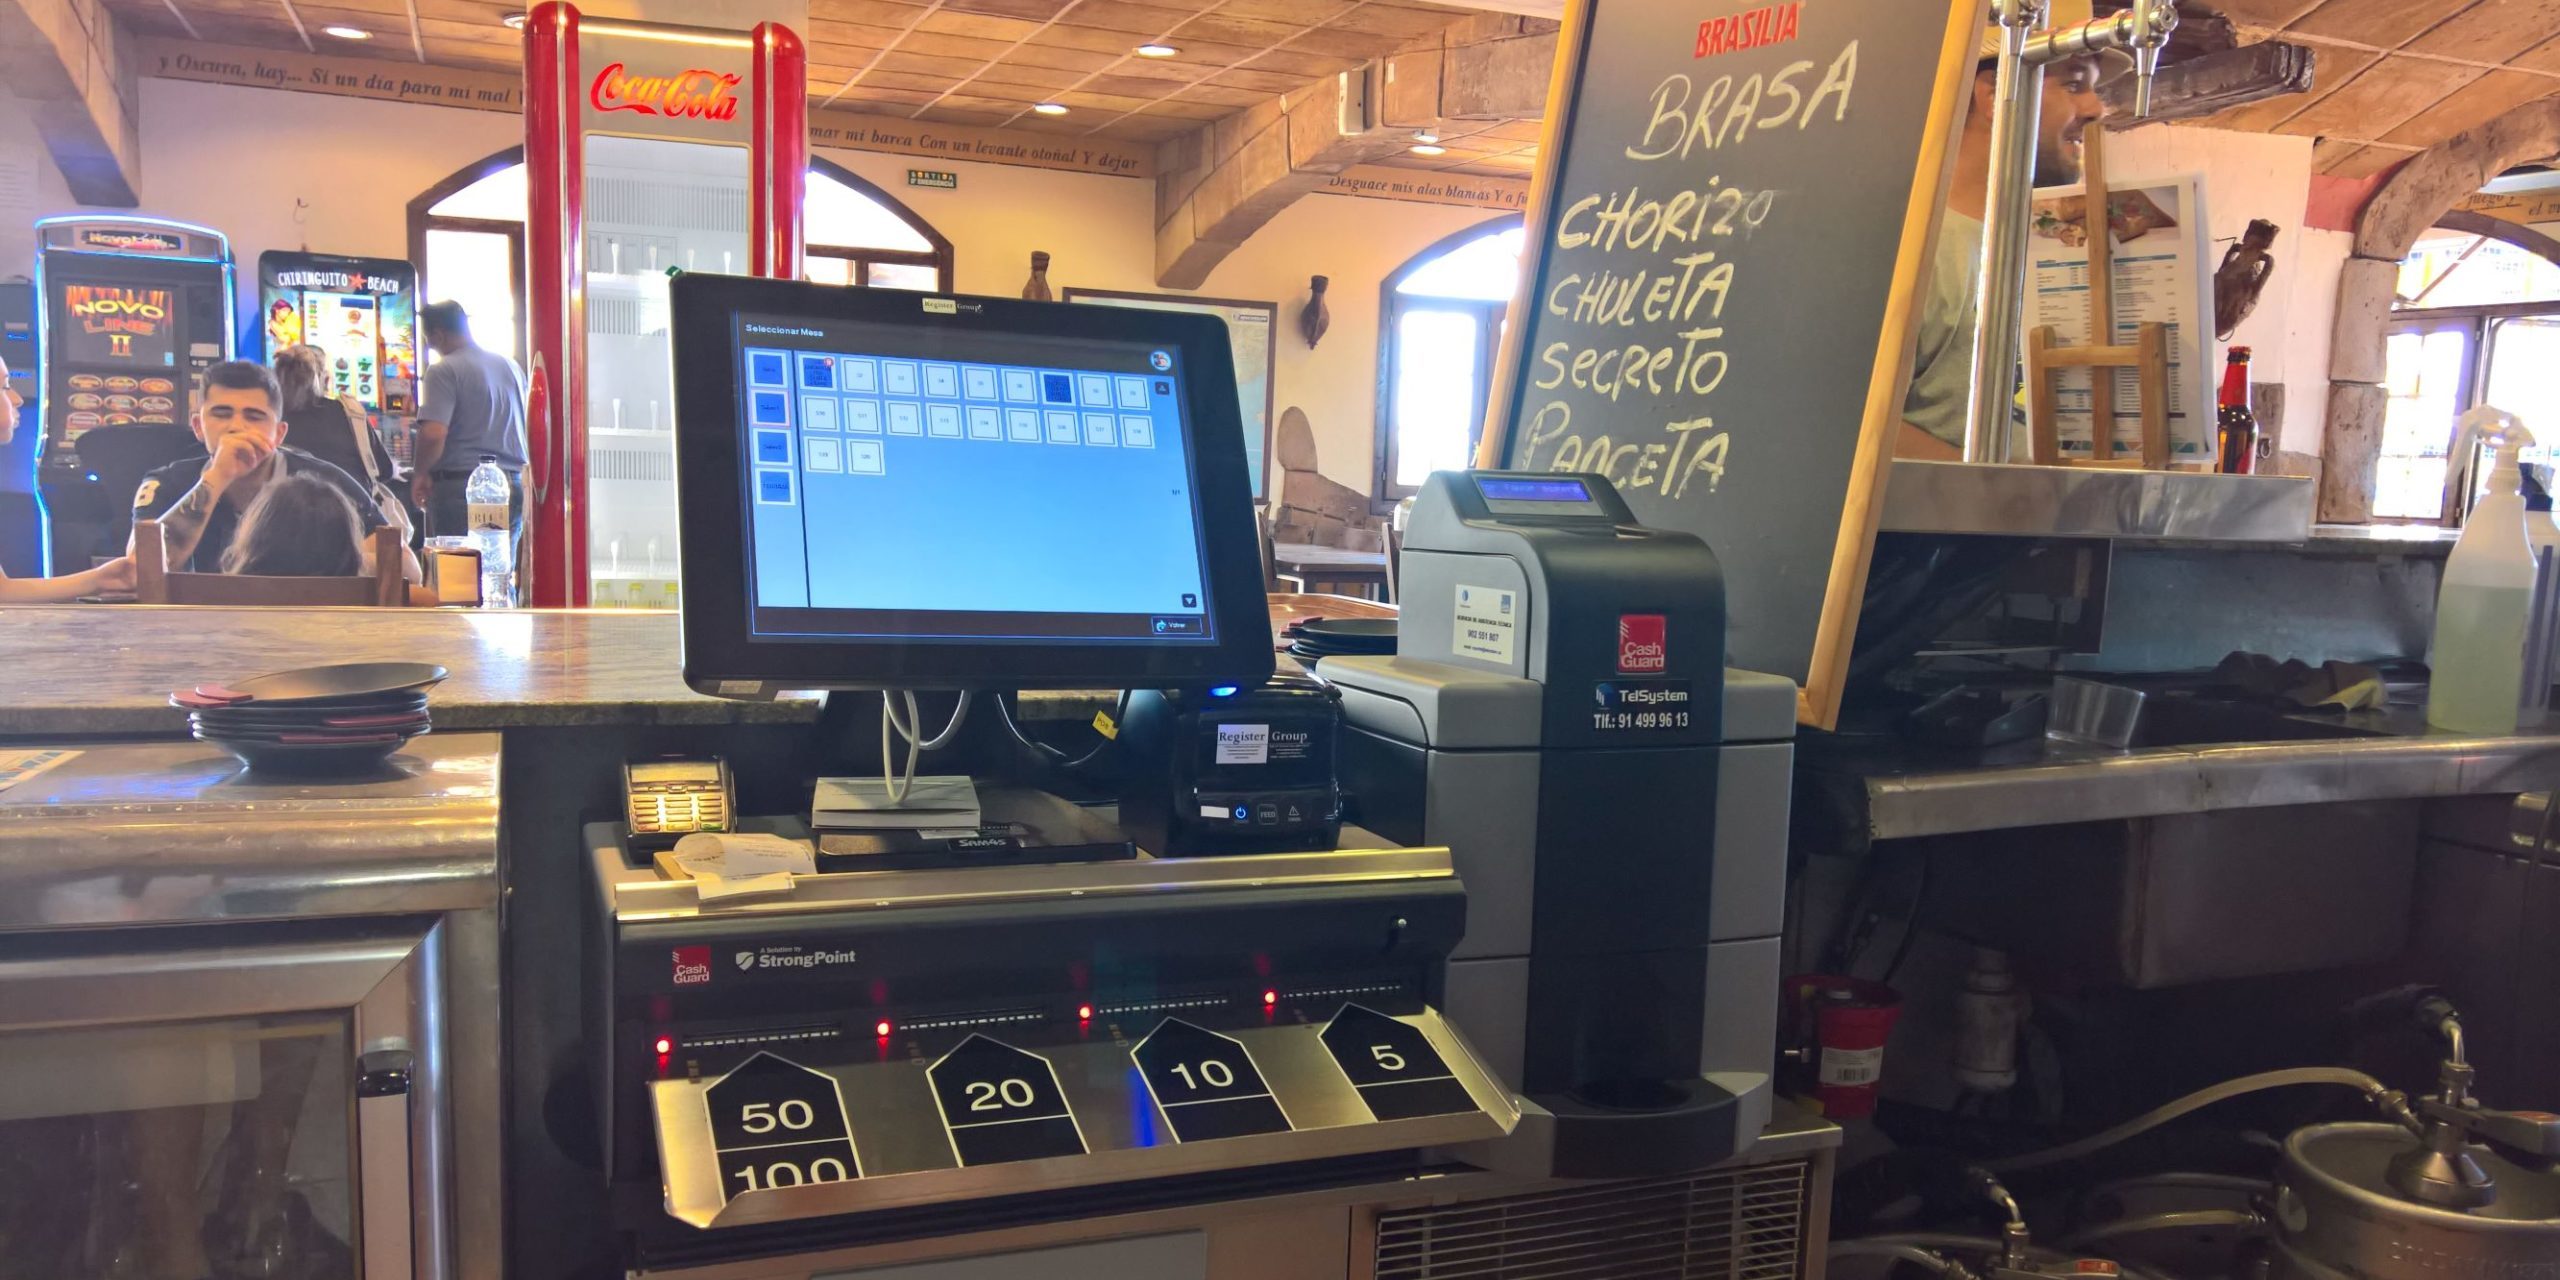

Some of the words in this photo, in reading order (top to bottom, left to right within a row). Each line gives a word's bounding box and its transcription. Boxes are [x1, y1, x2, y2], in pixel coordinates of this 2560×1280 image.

[1694, 3, 1799, 60] BRASILIA
[336, 73, 357, 88] un
[398, 80, 441, 98] para
[448, 86, 470, 100] mi
[477, 86, 510, 103] mal
[591, 63, 742, 121] Coca-Cola
[1625, 39, 1859, 161] BRASA
[809, 126, 840, 139] mar
[845, 128, 865, 141] mi
[871, 129, 912, 147] barca
[920, 133, 947, 150] Con
[953, 140, 970, 153] un
[975, 139, 1027, 158] levante
[1081, 151, 1095, 165] Y
[1099, 153, 1139, 172] dejar
[1329, 175, 1388, 193] Desguace
[1391, 181, 1413, 193] mis
[1416, 182, 1443, 196] alas
[1495, 189, 1504, 202] Y
[278, 271, 348, 287] CHIRINGUITO
[367, 276, 399, 294] BEACH
[1549, 252, 1735, 327] CHULETA
[74, 299, 165, 319] NOVO
[83, 317, 156, 336] LINE
[745, 323, 799, 335] Seleccionar
[800, 328, 824, 337] Mesa
[1620, 654, 1665, 668] Guard
[1625, 641, 1662, 656] Cash
[1619, 689, 1688, 705] TelSystem
[1593, 713, 1616, 729] Tlf.:
[1618, 713, 1632, 728] 91
[1635, 712, 1657, 728] 499
[1658, 712, 1672, 727] 96
[1676, 711, 1689, 727] 13
[1219, 731, 1266, 745] Register
[1271, 731, 1308, 744] Group
[676, 963, 707, 975] Cash
[759, 950, 856, 969] StrongPoint
[673, 971, 710, 984] Guard
[1370, 1044, 1406, 1071] 5
[1171, 1060, 1234, 1090] 10
[965, 1078, 1035, 1112] 20
[742, 1099, 814, 1134] 50
[735, 1157, 847, 1191] 100
